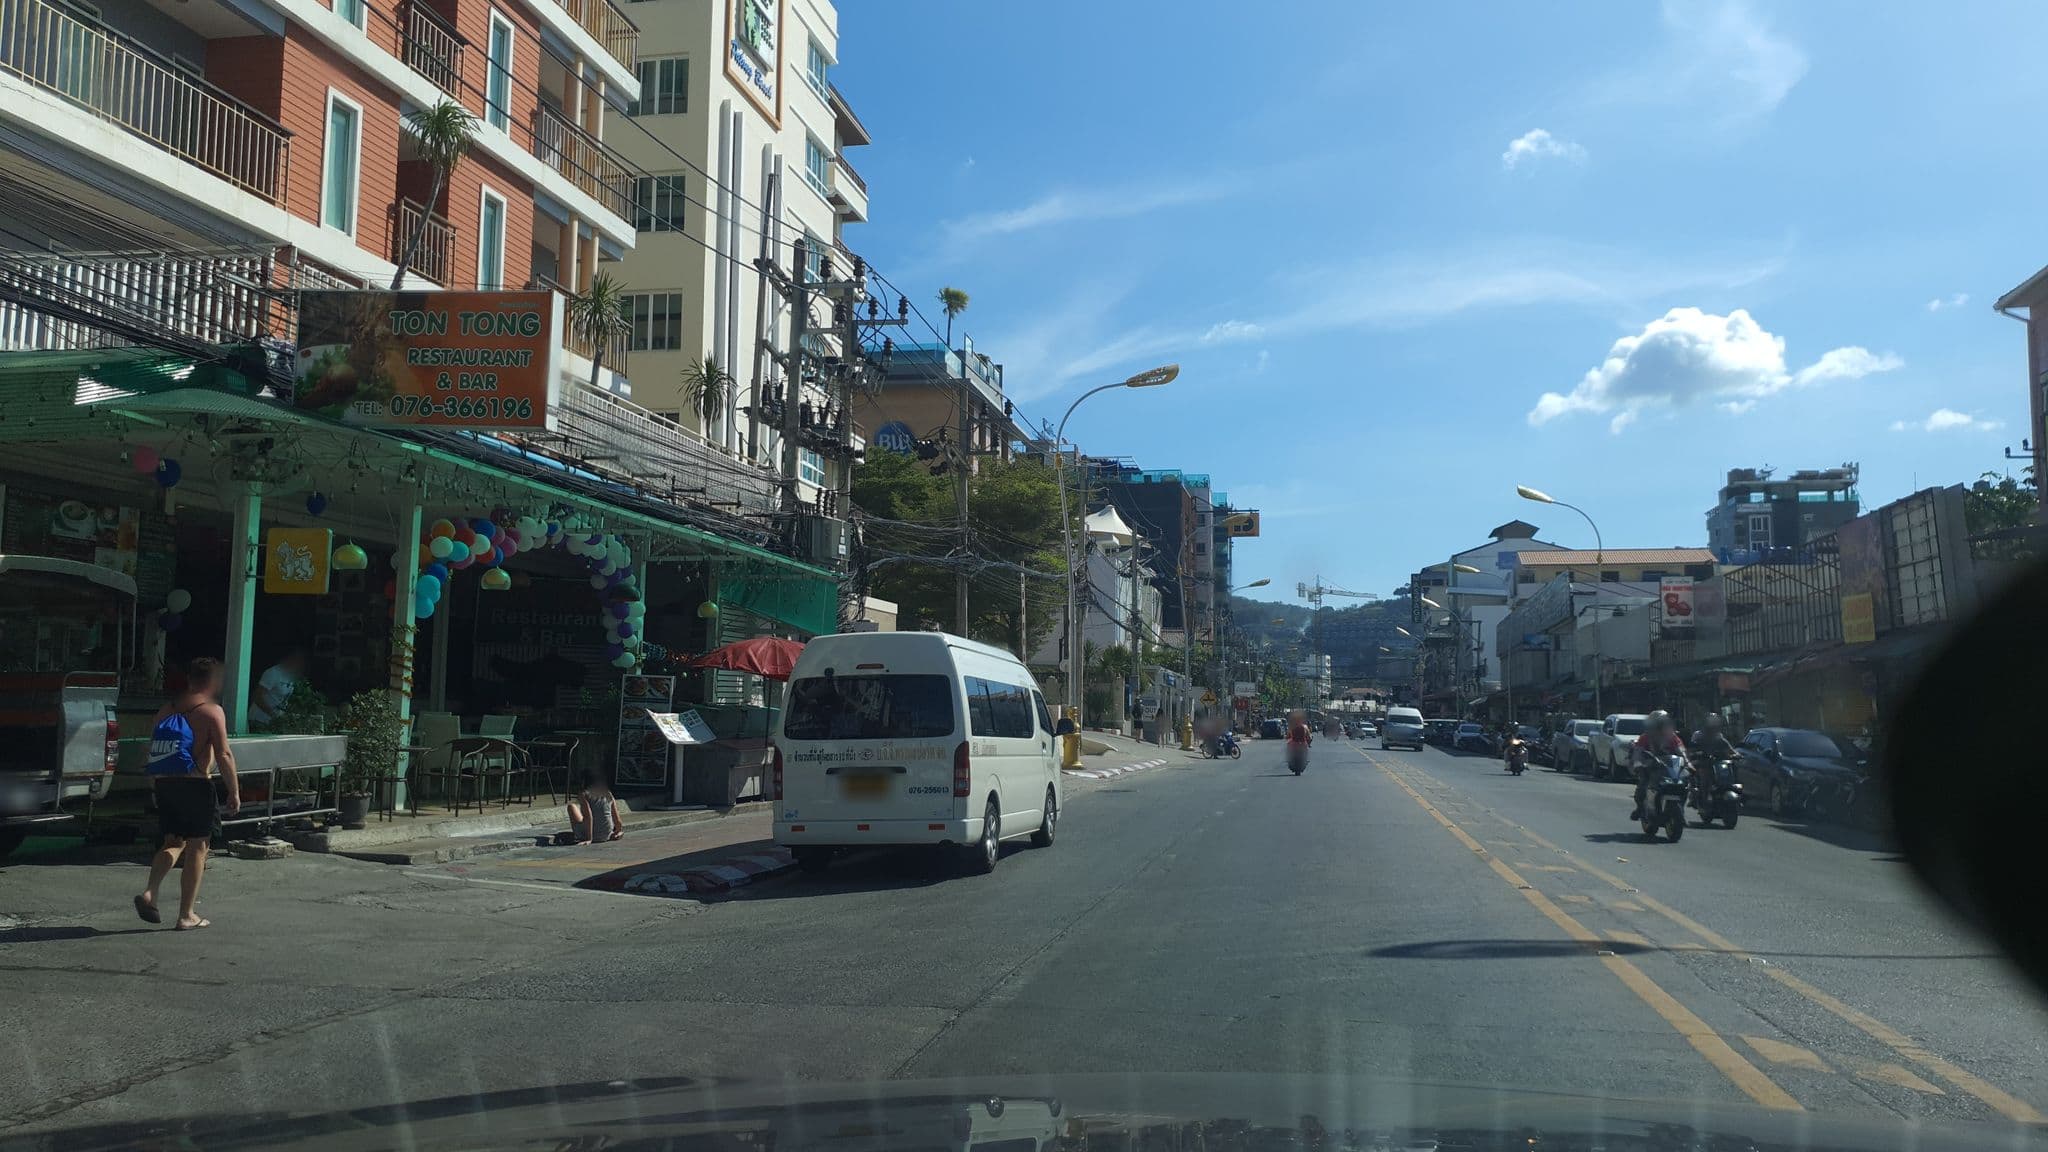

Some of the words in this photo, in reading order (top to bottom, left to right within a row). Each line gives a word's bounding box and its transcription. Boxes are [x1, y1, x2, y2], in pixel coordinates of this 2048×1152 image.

[389, 310, 448, 336] TON
[458, 311, 541, 337] TONG
[407, 348, 533, 367] RESTAURANT
[436, 372, 452, 389] &
[458, 372, 498, 391] BAR
[354, 401, 384, 415] TEL:
[389, 395, 533, 419] 076-366196
[151, 740, 180, 752] NIKE
